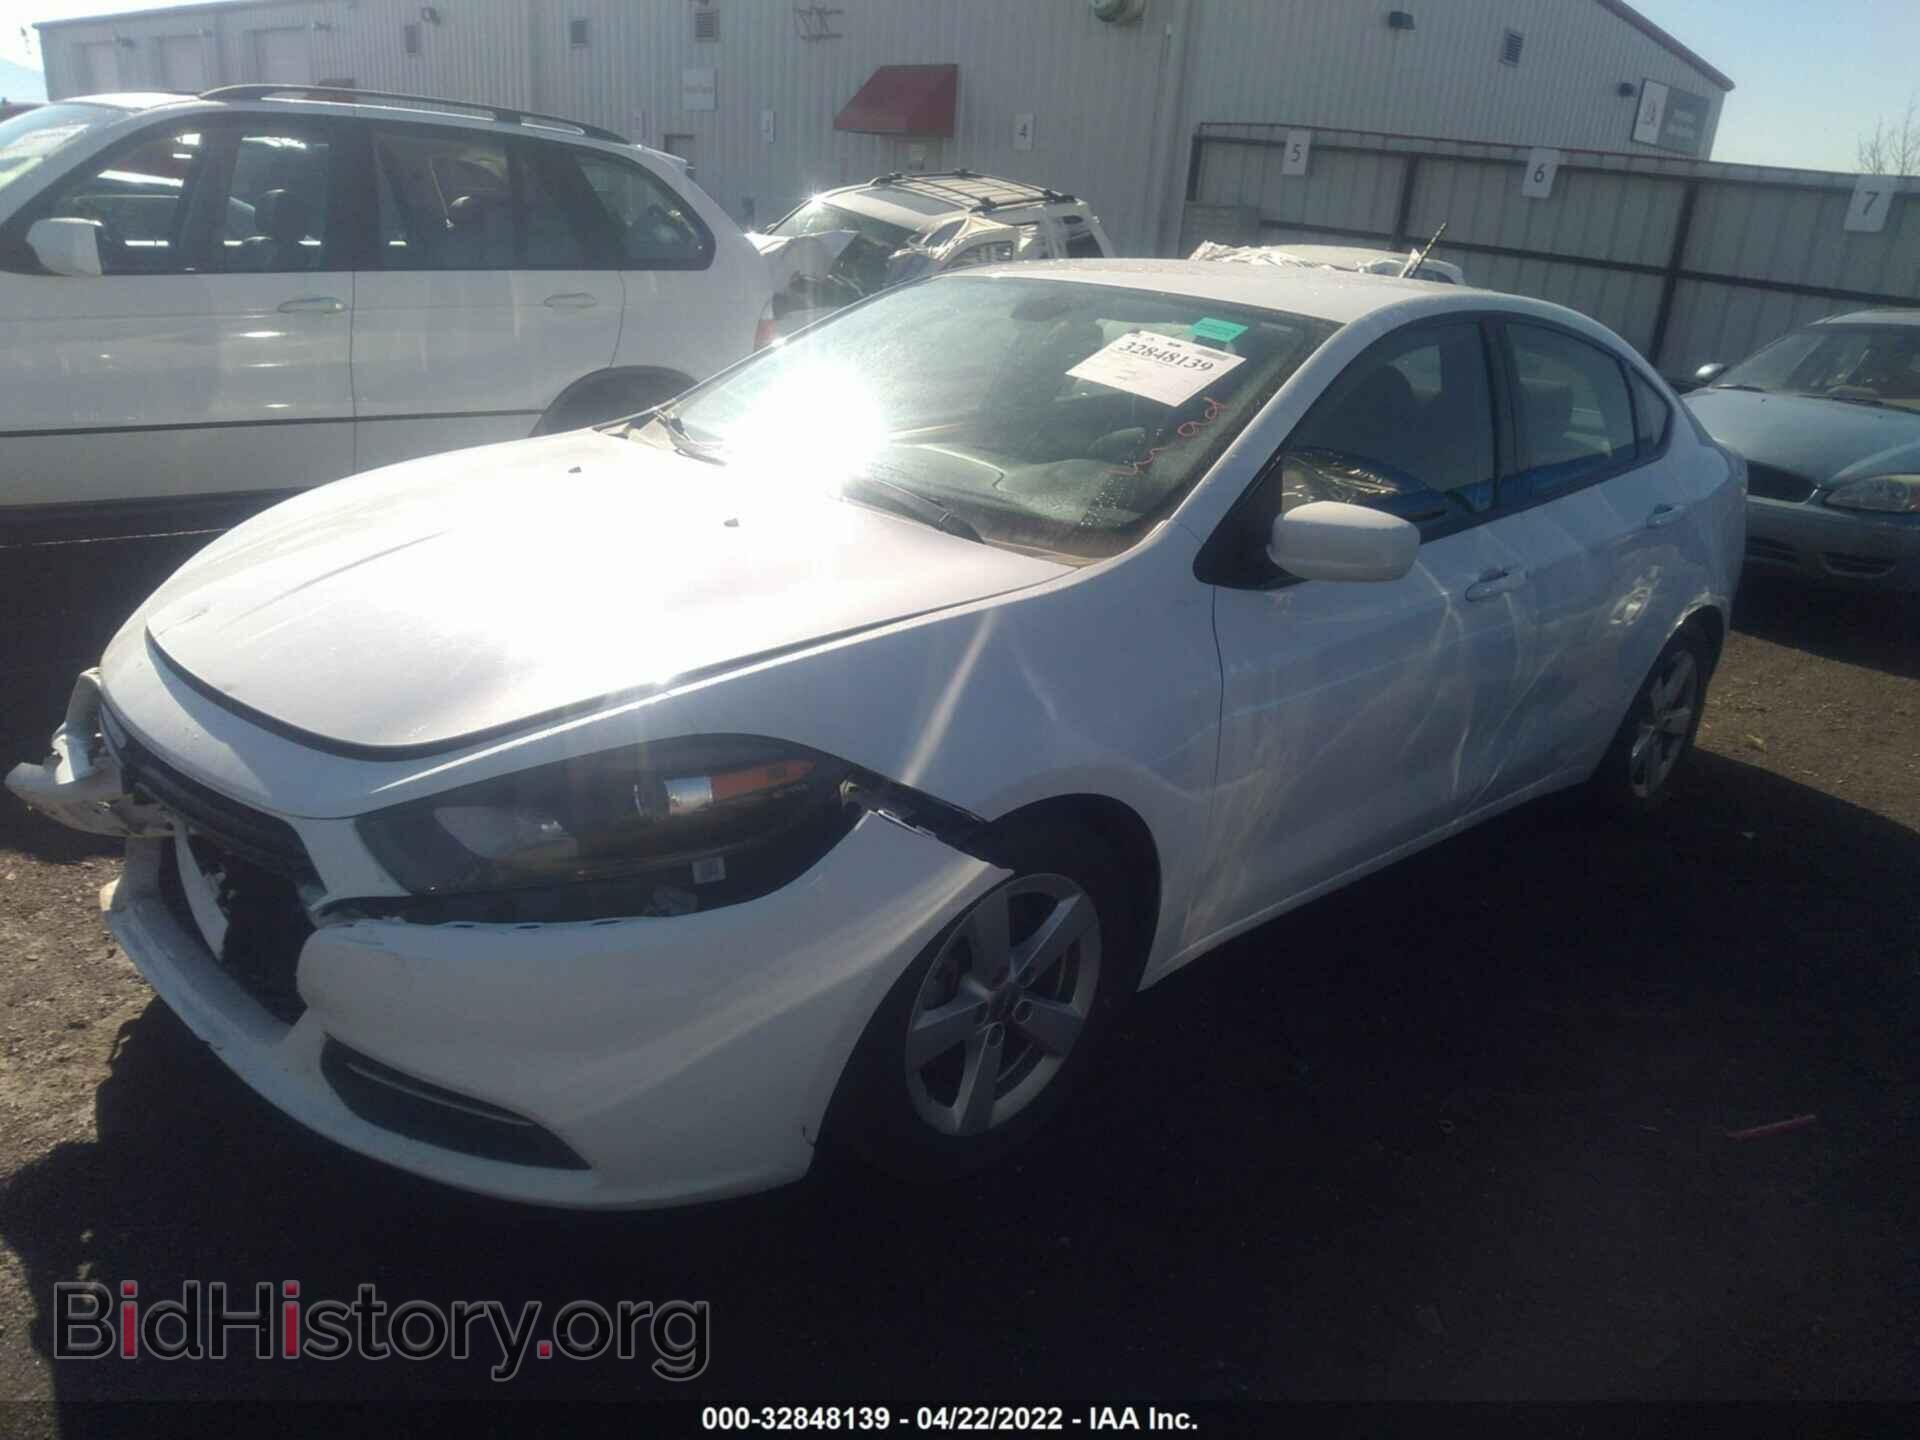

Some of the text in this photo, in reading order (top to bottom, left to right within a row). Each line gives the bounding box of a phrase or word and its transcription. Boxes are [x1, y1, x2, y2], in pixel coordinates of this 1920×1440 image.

[1015, 123, 1027, 140] 4
[1288, 143, 1305, 162] 5
[1533, 162, 1546, 183] 6
[1863, 190, 1879, 216] 7
[1119, 341, 1214, 372] 32848139
